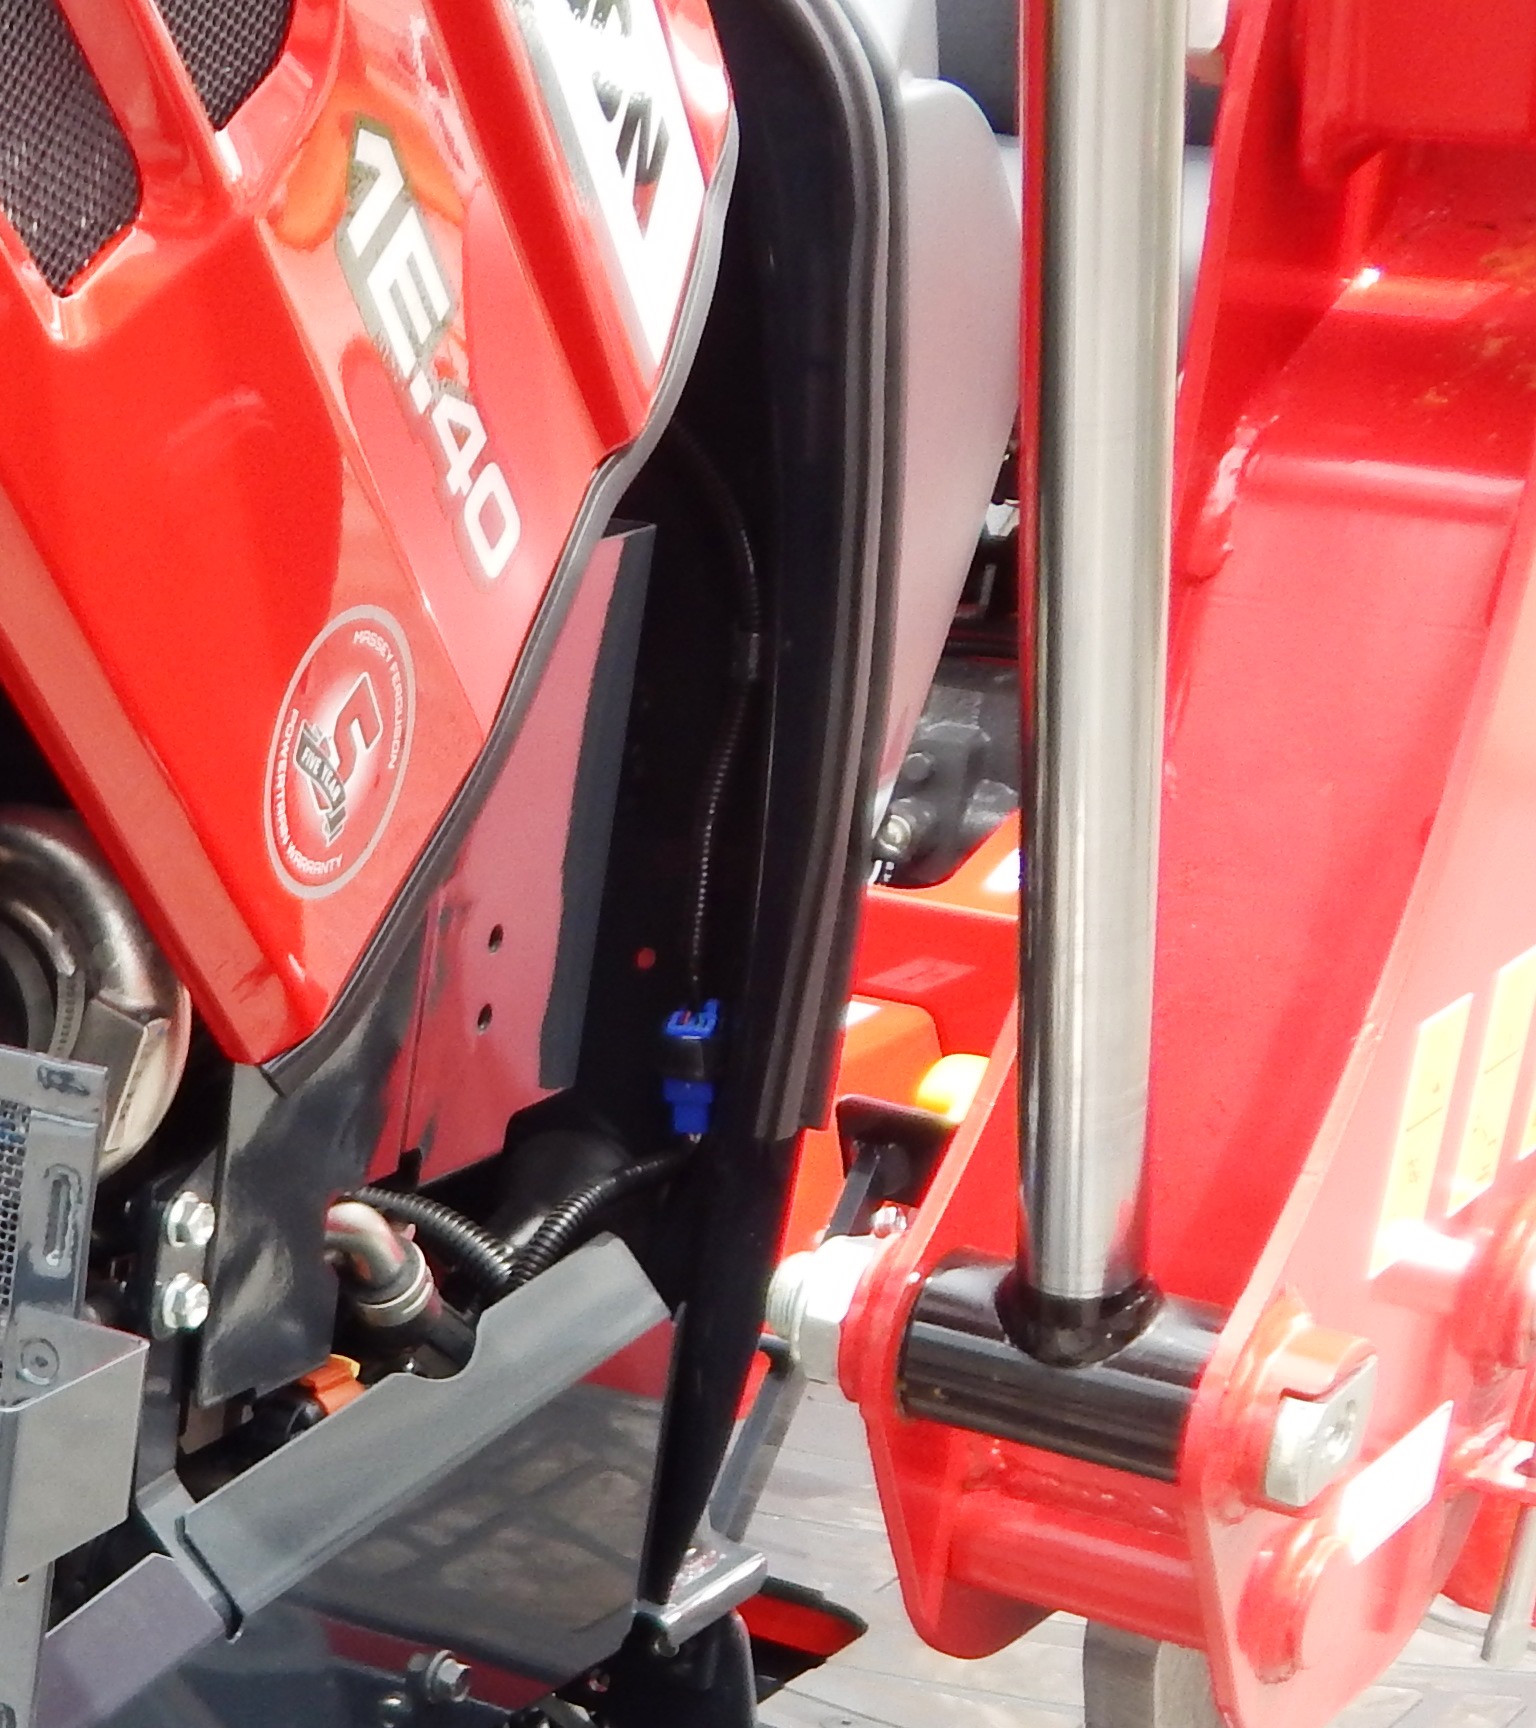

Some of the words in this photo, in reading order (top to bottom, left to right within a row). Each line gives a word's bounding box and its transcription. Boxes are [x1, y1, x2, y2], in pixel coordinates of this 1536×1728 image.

[351, 629, 393, 663] MASSEY
[386, 660, 403, 769] FERGUSON
[275, 707, 300, 843] POWERTRAIN
[300, 743, 322, 774] FIVE
[321, 761, 341, 801] YEAR
[286, 838, 343, 876] WARRANTY
